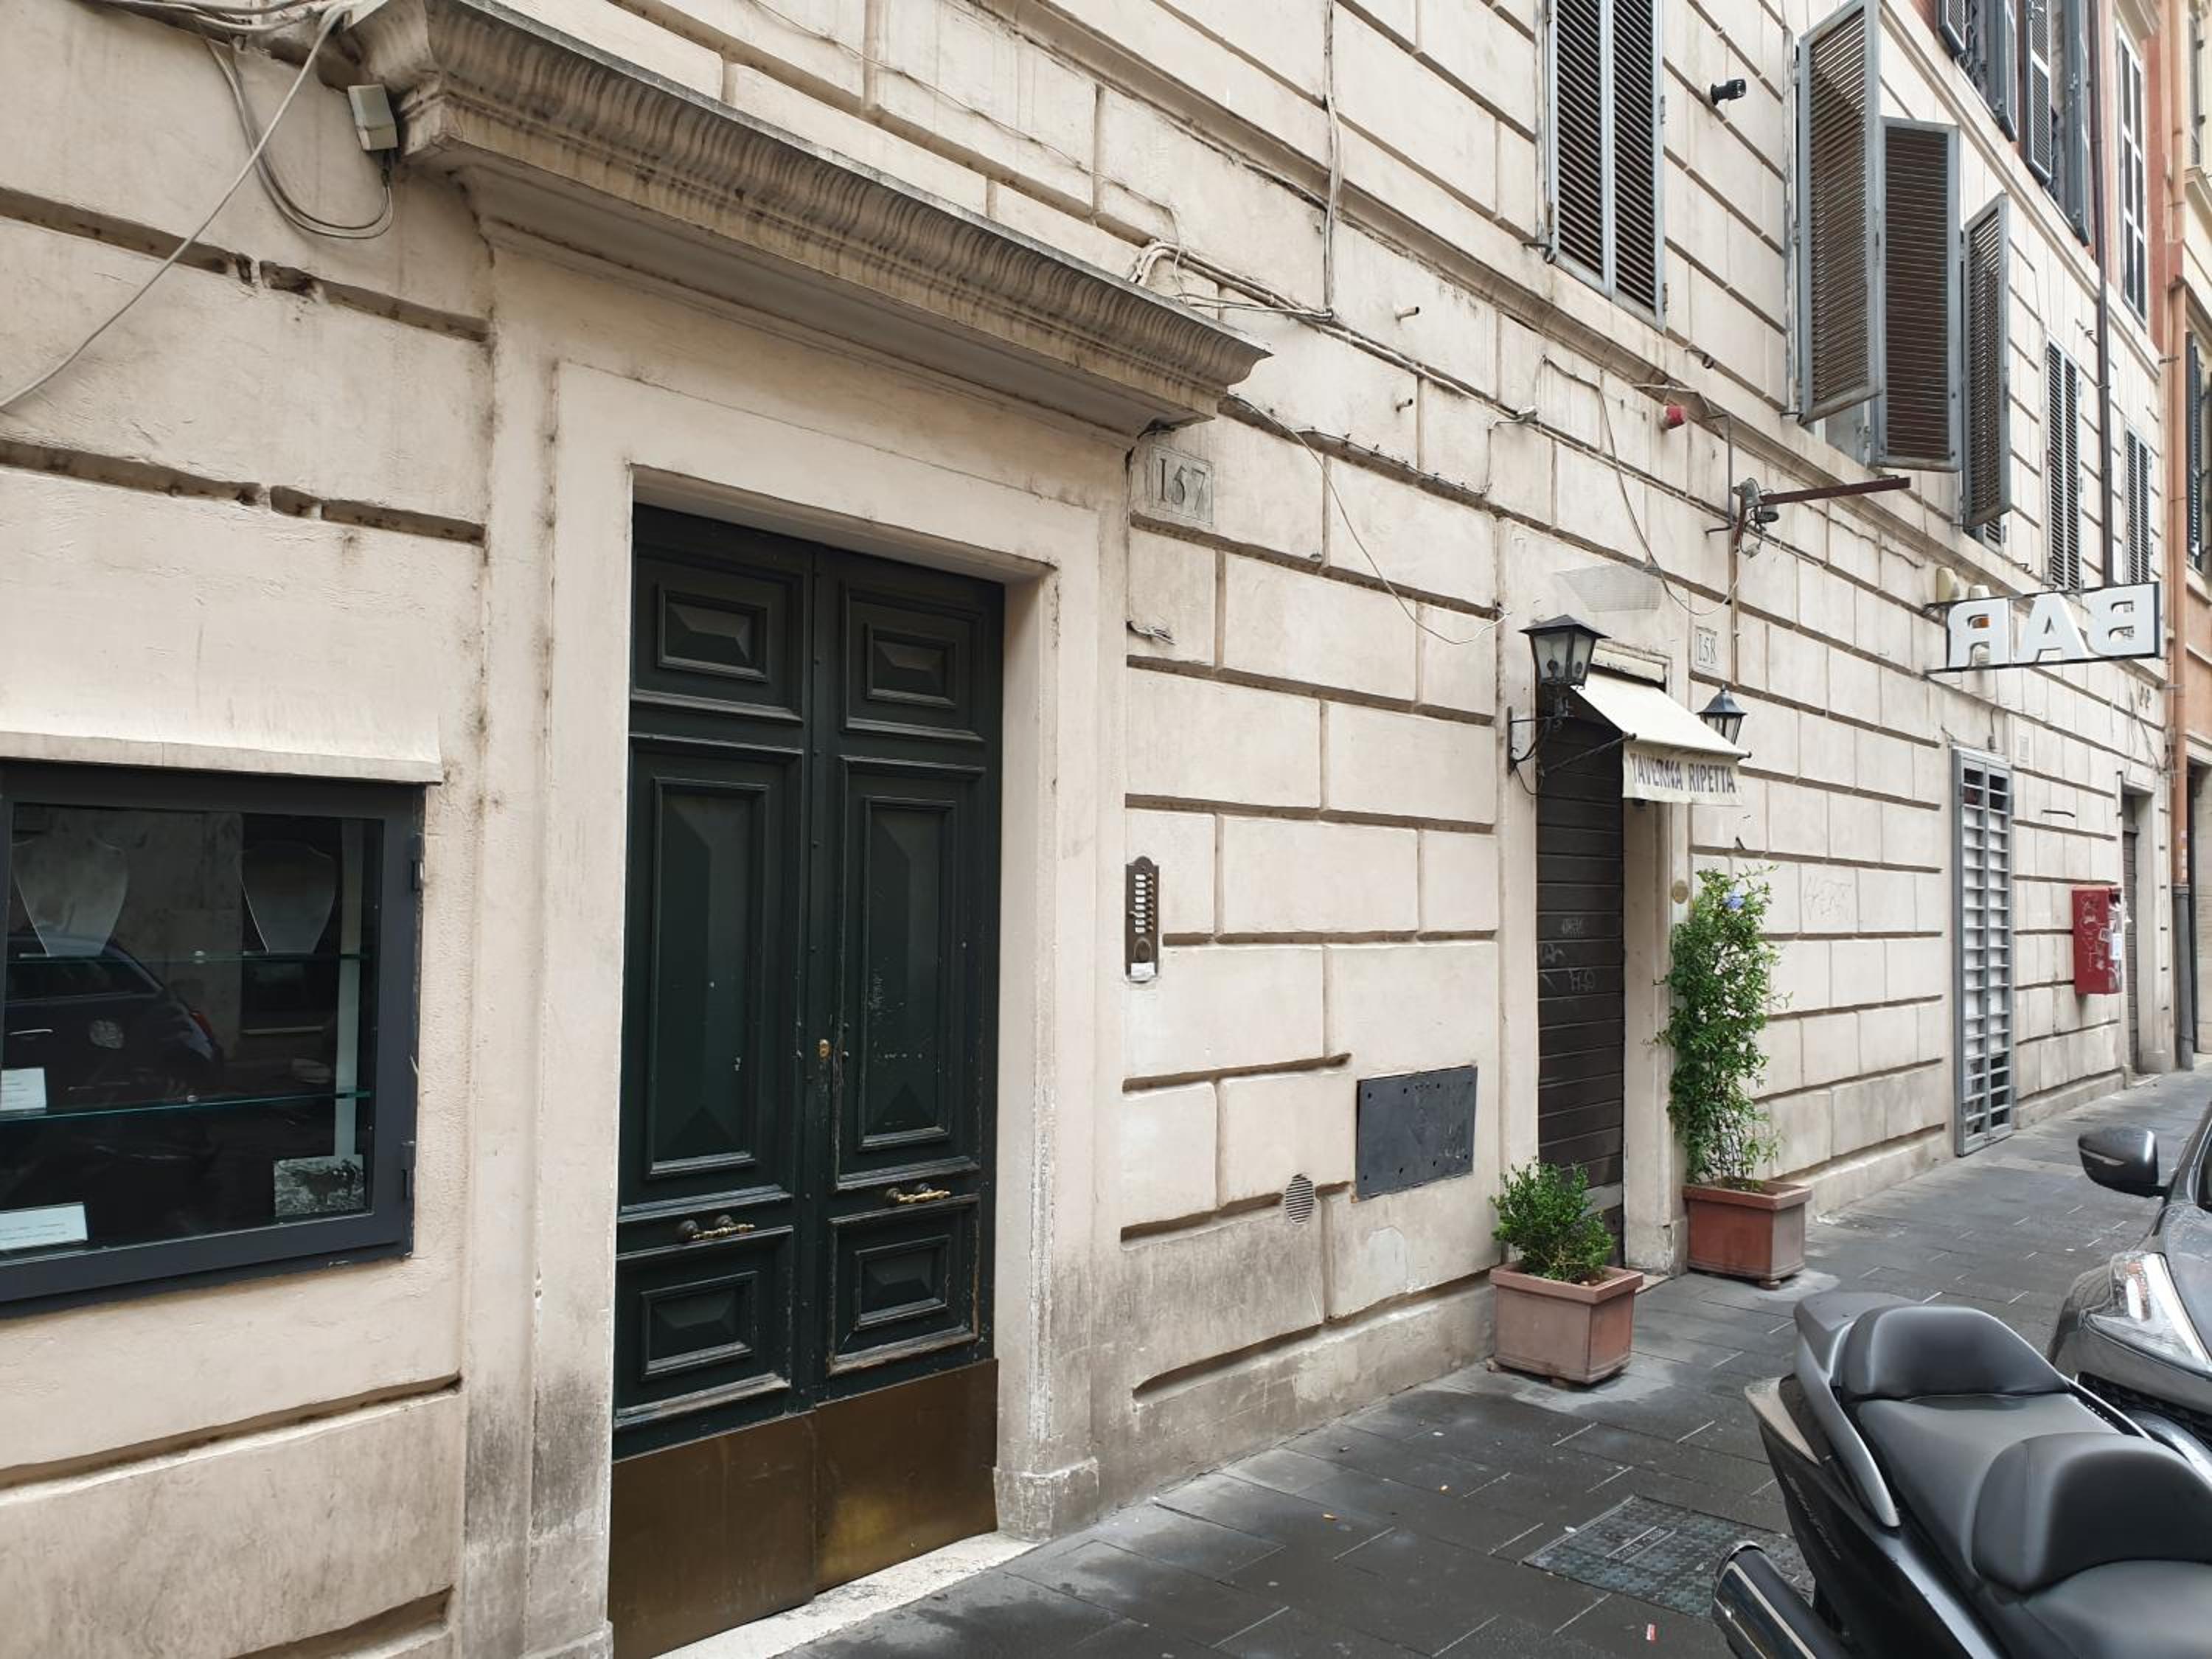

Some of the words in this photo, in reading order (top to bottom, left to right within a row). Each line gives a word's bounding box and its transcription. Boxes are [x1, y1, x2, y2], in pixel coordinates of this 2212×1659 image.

[1158, 456, 1206, 511] 157
[1629, 752, 1683, 791] TAVERNA
[1688, 762, 1736, 793] RIPETTA
